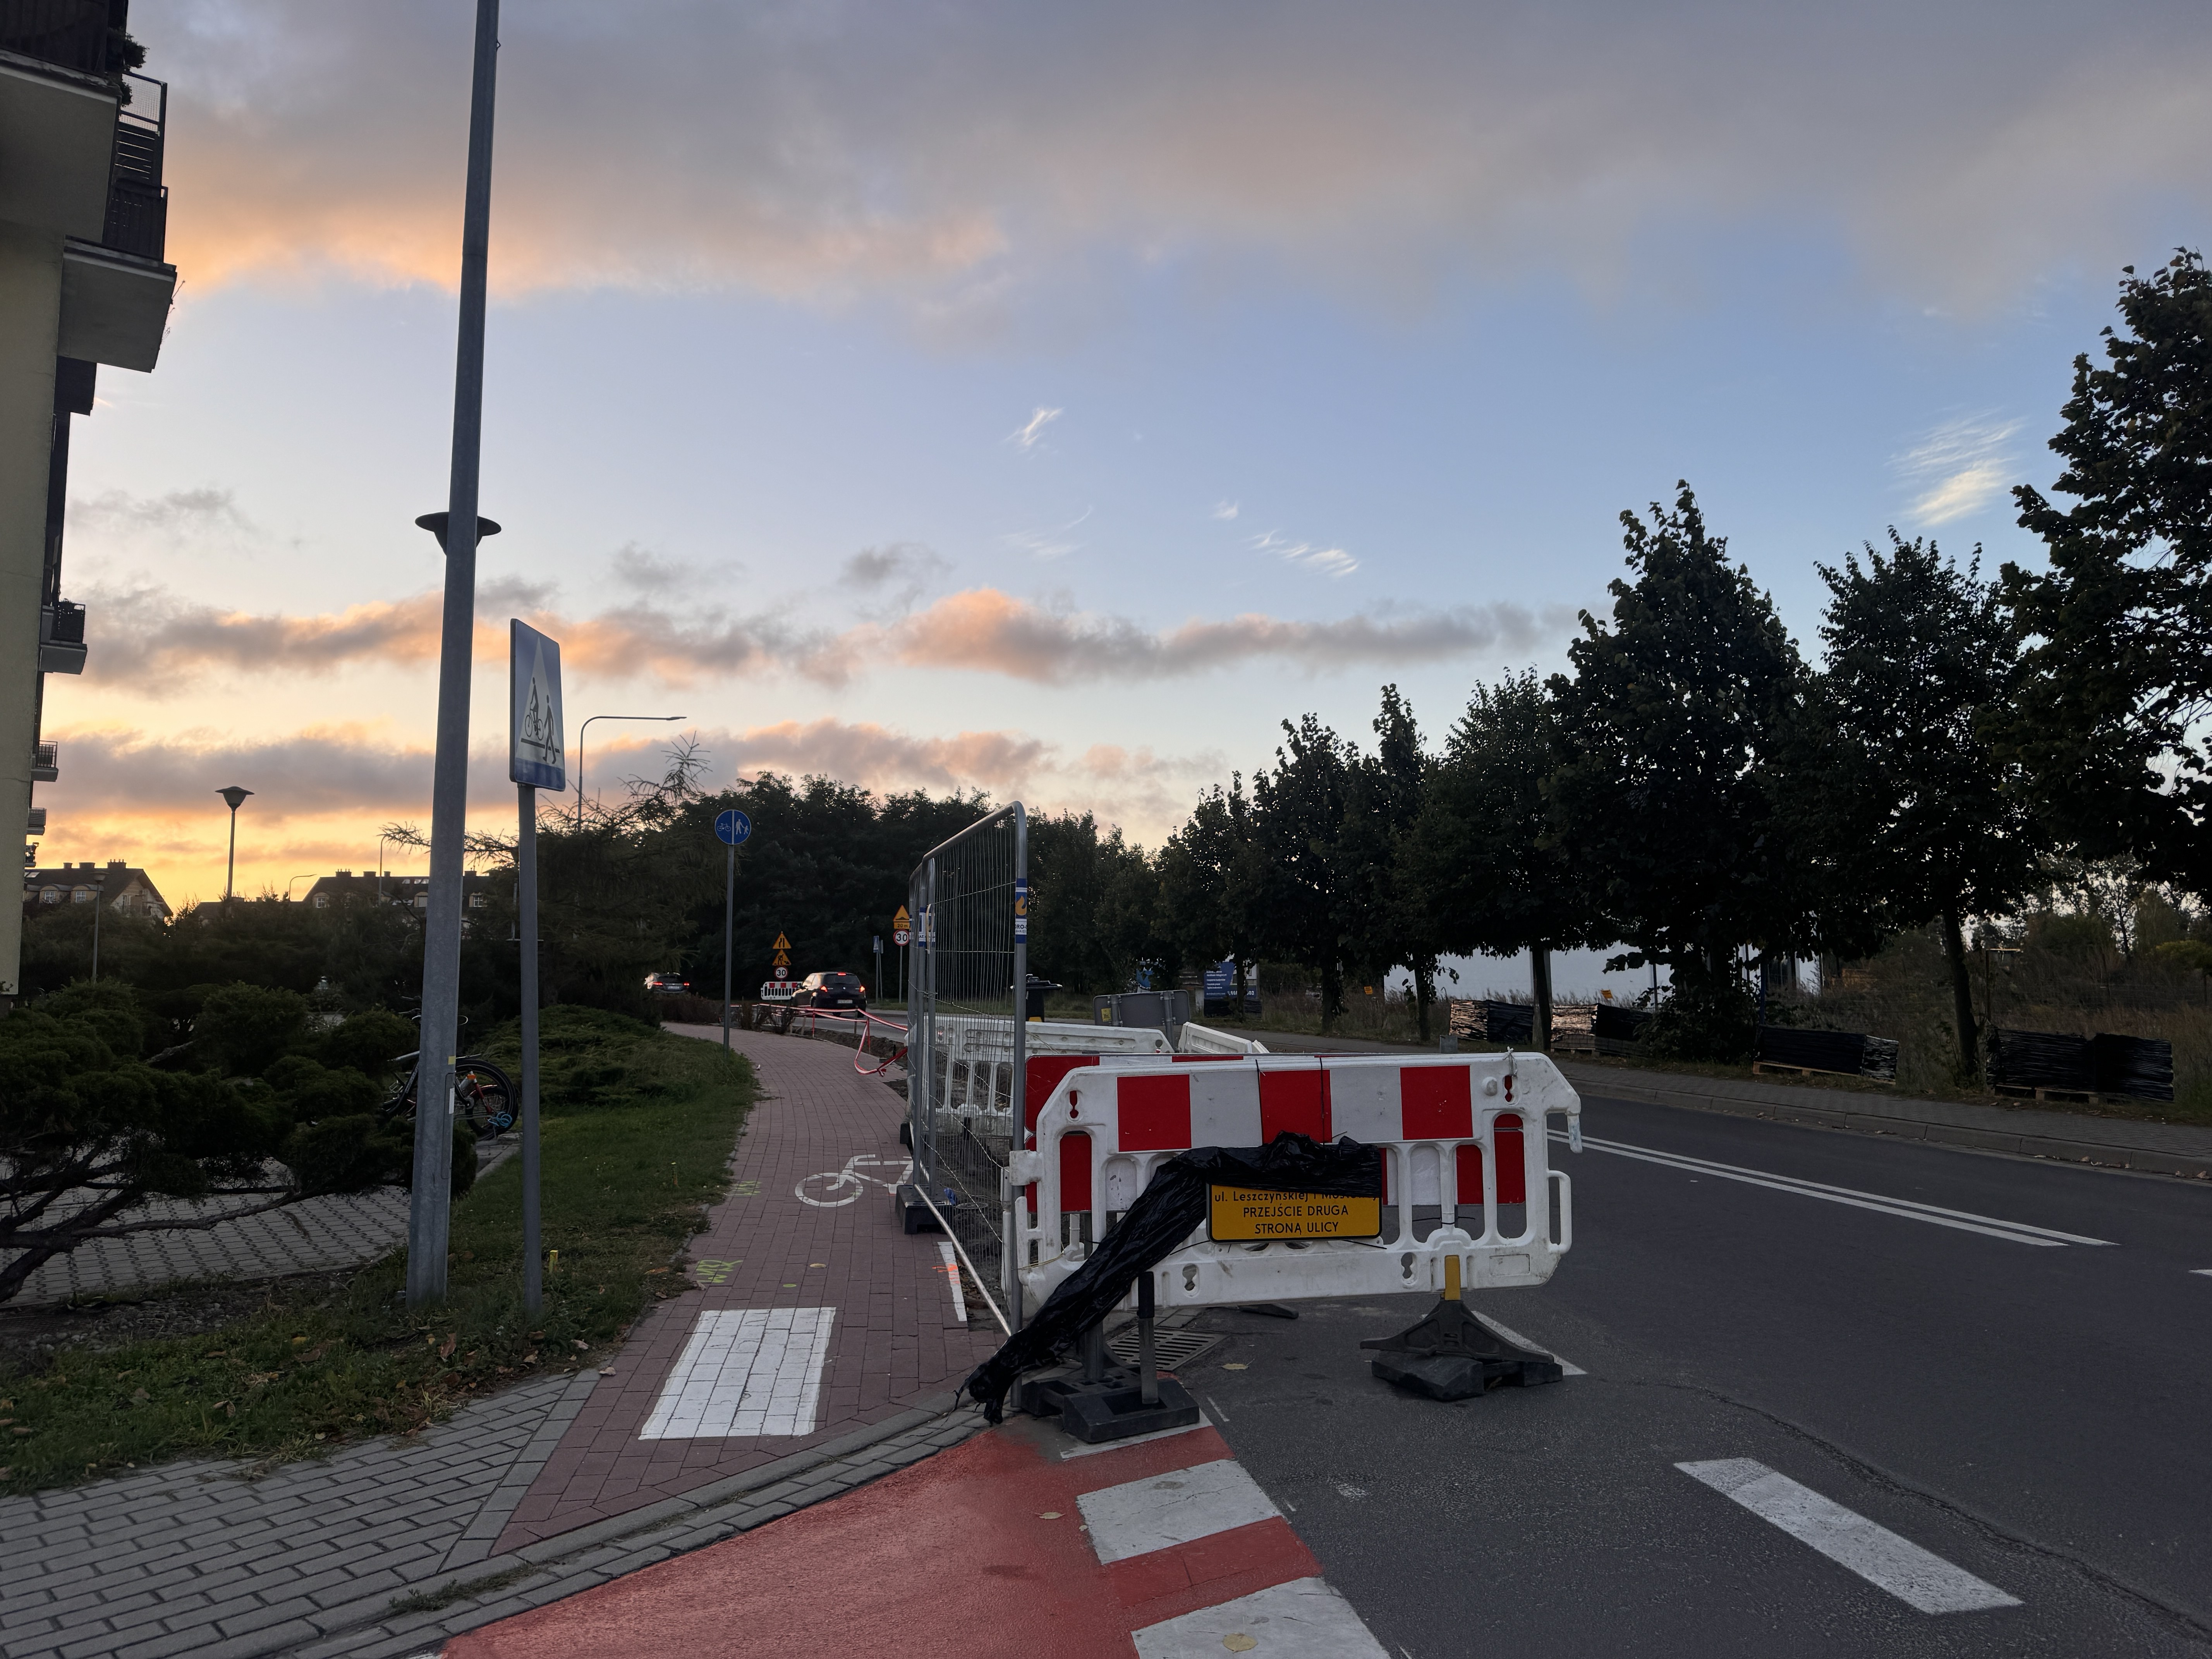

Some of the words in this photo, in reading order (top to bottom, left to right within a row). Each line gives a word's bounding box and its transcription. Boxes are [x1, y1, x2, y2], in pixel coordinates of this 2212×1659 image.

[896, 933, 907, 941] 30
[1215, 1192, 1227, 1202] ul.
[1243, 1204, 1302, 1218] PRZEJŚCIE
[1308, 1205, 1348, 1216] DRUGA
[1255, 1223, 1302, 1235] STRONĄ
[1307, 1221, 1338, 1232] ULICY
